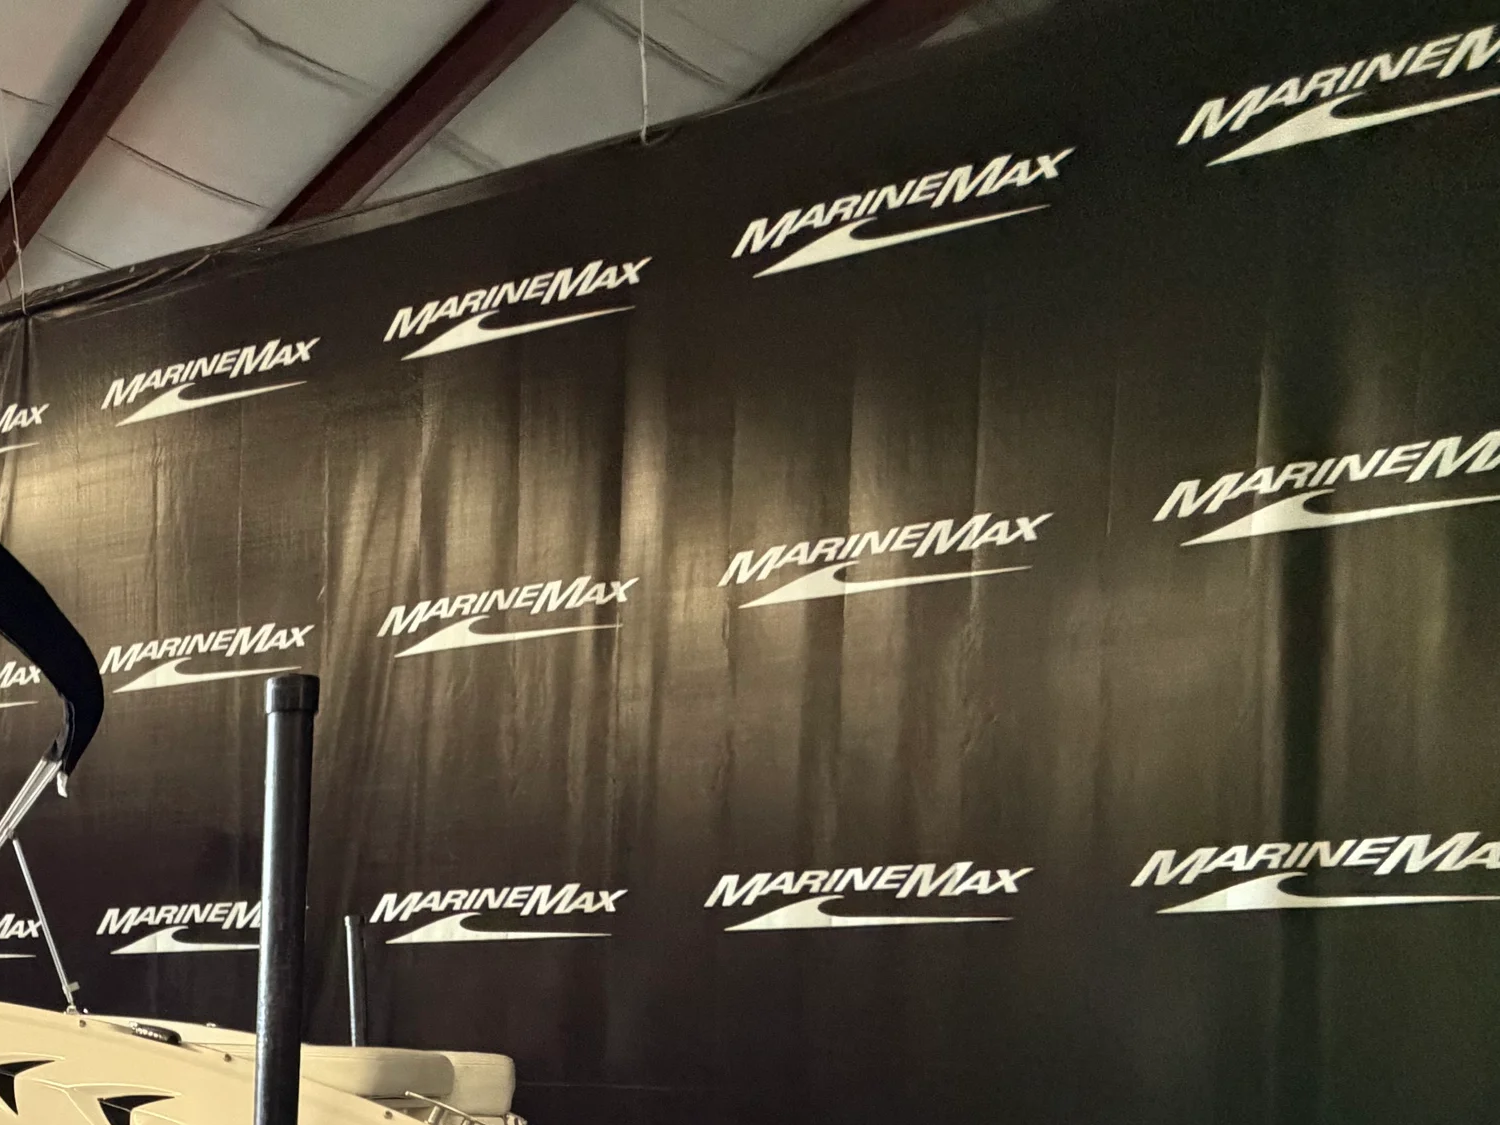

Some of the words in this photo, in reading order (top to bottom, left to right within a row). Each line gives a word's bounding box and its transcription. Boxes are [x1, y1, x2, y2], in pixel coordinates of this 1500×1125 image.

[1177, 24, 1500, 145] MARINEM
[1153, 429, 1500, 523] MARINEM
[1130, 831, 1500, 888] MARINEMA
[96, 901, 262, 935] MARINEM
